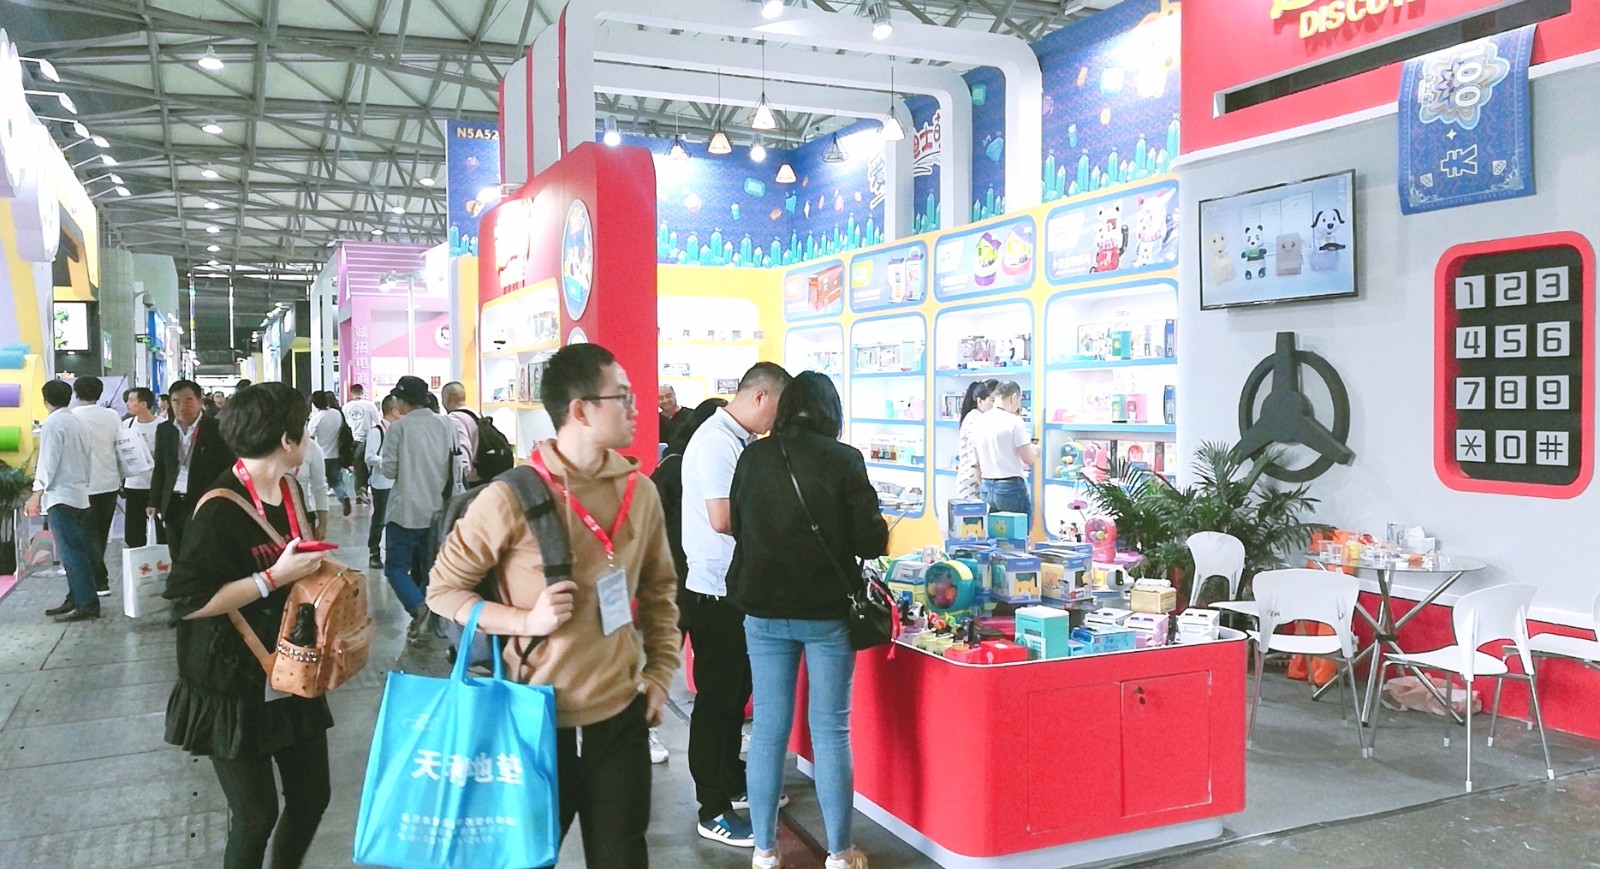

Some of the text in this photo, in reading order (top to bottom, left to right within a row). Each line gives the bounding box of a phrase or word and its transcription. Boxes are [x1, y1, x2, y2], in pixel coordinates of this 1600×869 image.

[456, 127, 499, 140] N5A52
[1503, 276, 1521, 301] 2
[1541, 273, 1561, 299] 3
[1463, 327, 1562, 355] 4 5 6
[1463, 380, 1561, 405] 7 8 9
